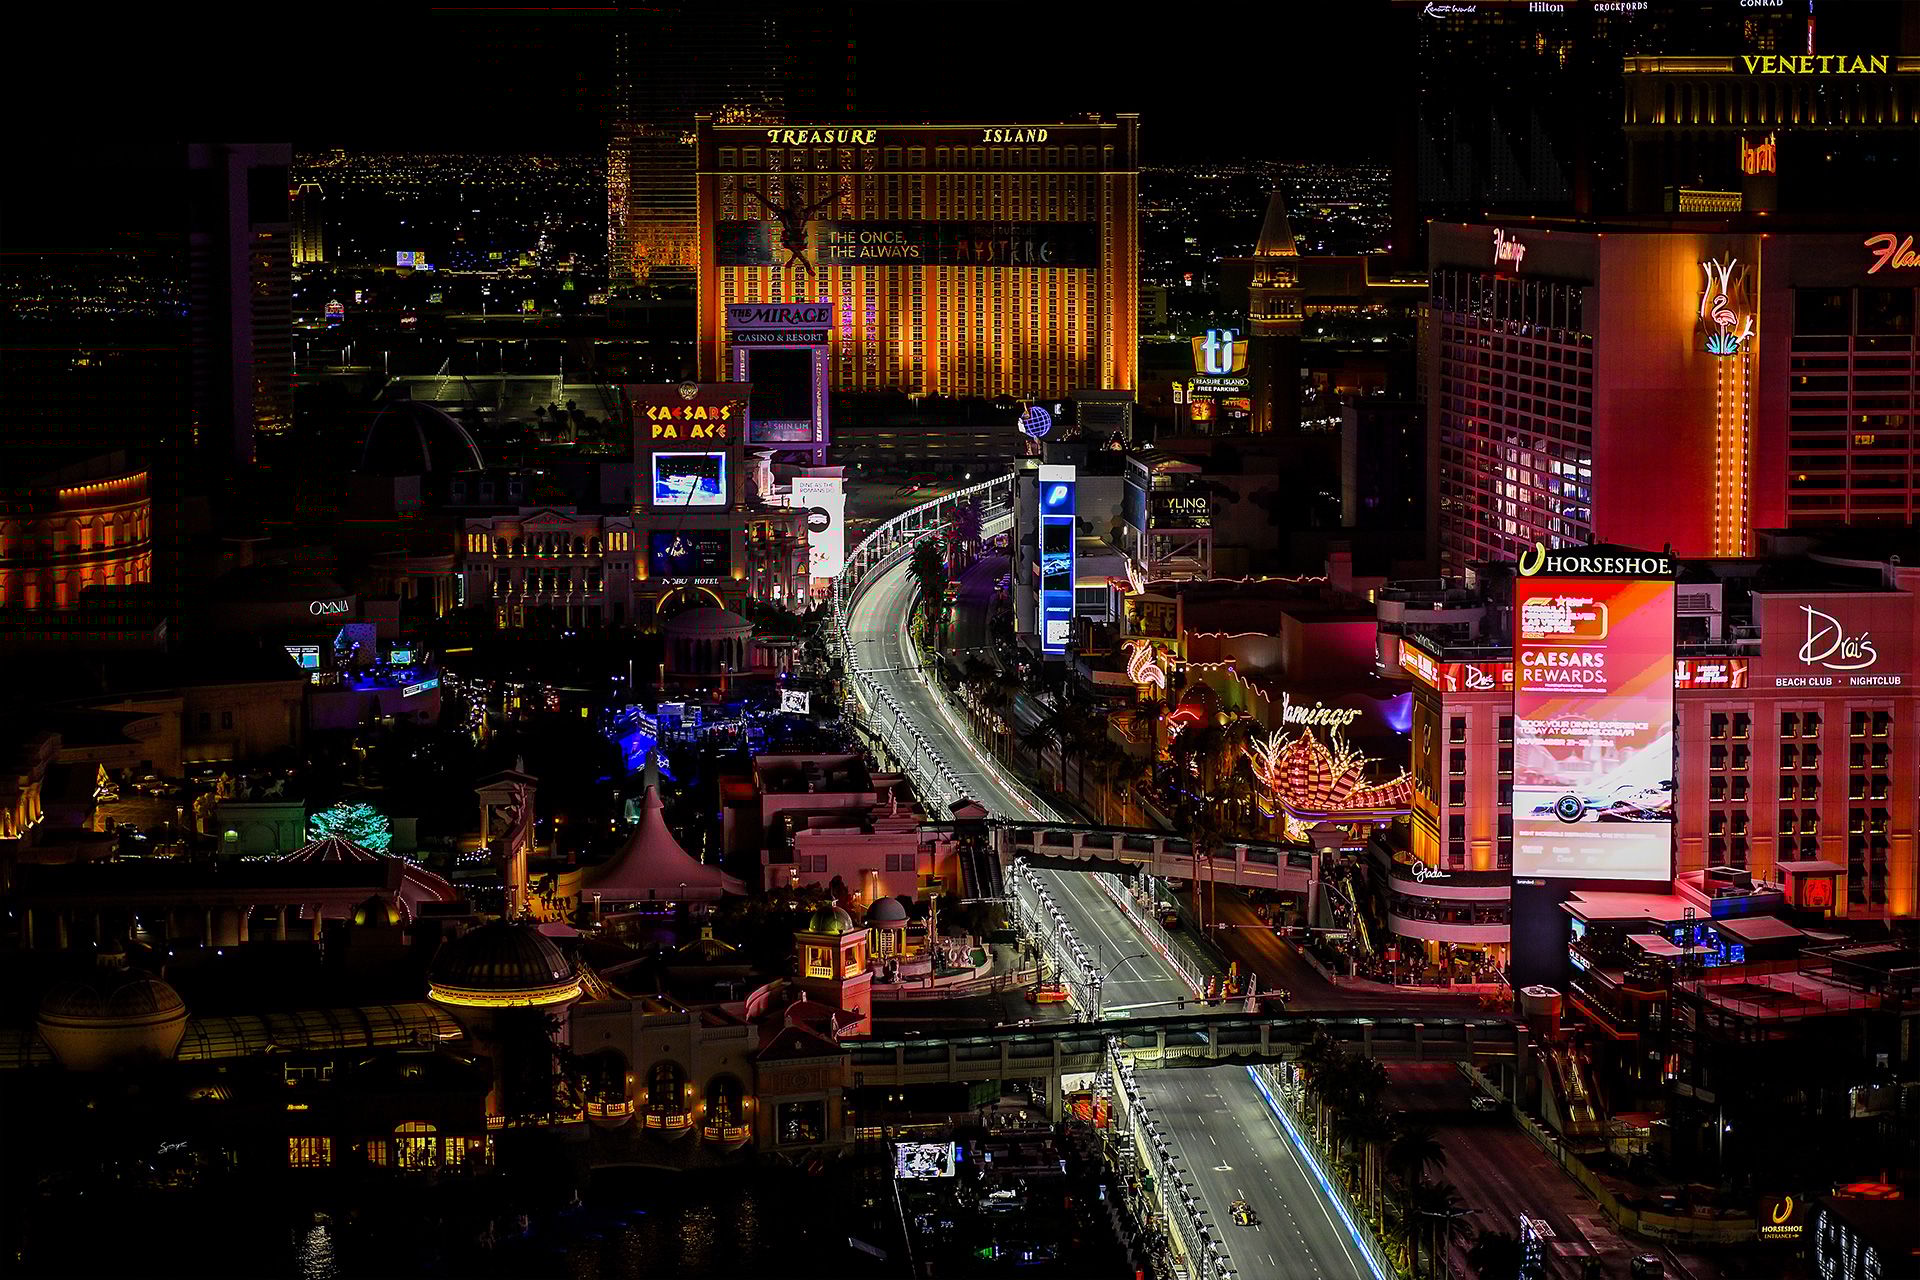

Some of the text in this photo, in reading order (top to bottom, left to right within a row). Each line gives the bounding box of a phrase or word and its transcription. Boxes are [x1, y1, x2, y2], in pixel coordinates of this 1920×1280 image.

[1529, 2, 1564, 12] Hilton
[1594, 2, 1648, 11] CROCKFORDS
[1741, 55, 1889, 74] VENETIAN
[767, 129, 1048, 145] TREASURE ISLAND
[830, 231, 907, 245] THE ONCE,
[829, 245, 919, 258] THE ALWAYS
[730, 308, 829, 324] THE MIRAGE
[1202, 329, 1234, 375] ti
[647, 406, 731, 420] CAESARS
[1798, 604, 1878, 670] Drai's
[1521, 651, 1605, 668] CAESARS
[1775, 676, 1902, 686] BEACH CLUB NIGHTCLUB
[1519, 727, 1546, 735] TODAY
[1546, 720, 1570, 728] YOUR
[1761, 1225, 1804, 1233] HORSESHOE
